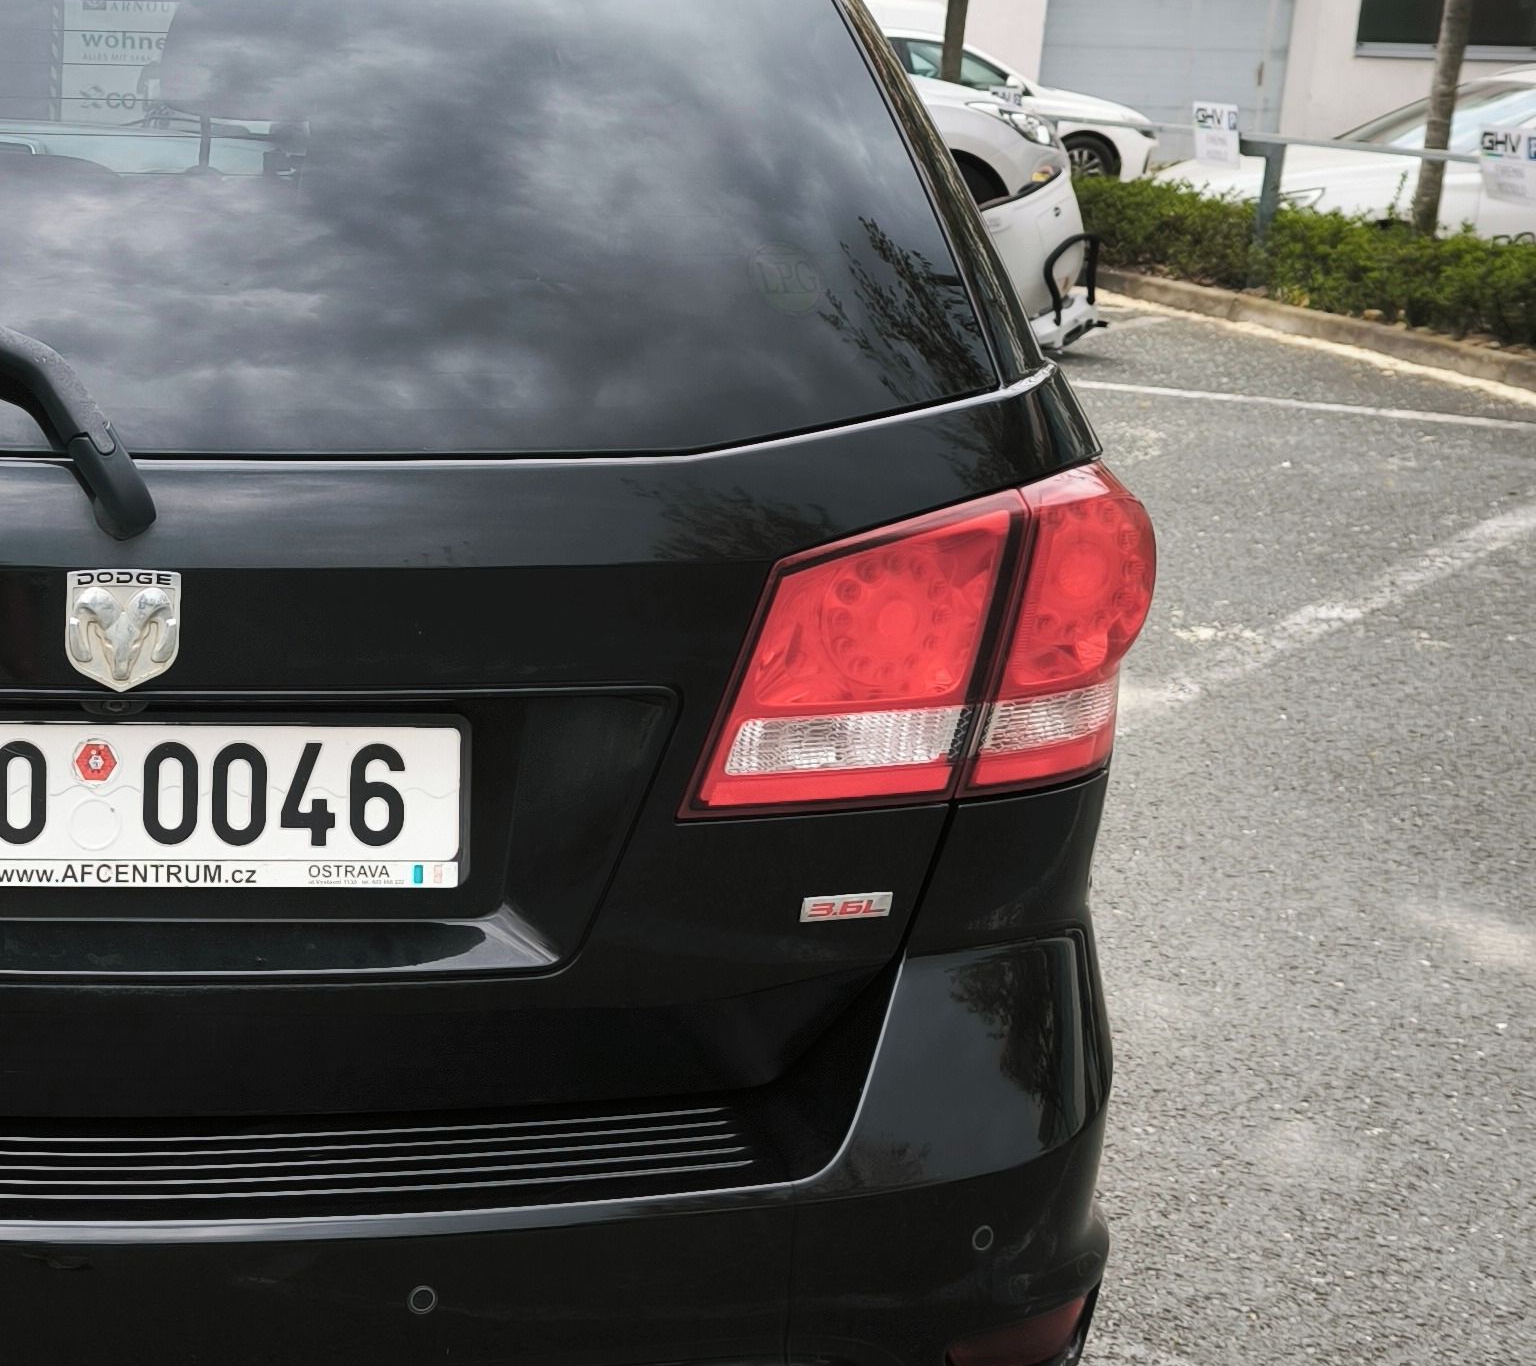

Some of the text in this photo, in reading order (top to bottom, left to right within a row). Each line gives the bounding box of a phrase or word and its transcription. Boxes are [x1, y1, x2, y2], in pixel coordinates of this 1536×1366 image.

[110, 2, 175, 12] ARNOU
[1480, 131, 1521, 153] GHV
[756, 260, 817, 295] LPG
[76, 571, 172, 586] DODGE
[143, 741, 406, 847] 0046
[308, 864, 390, 878] OSTRAVA
[807, 899, 887, 918] 3.6L
